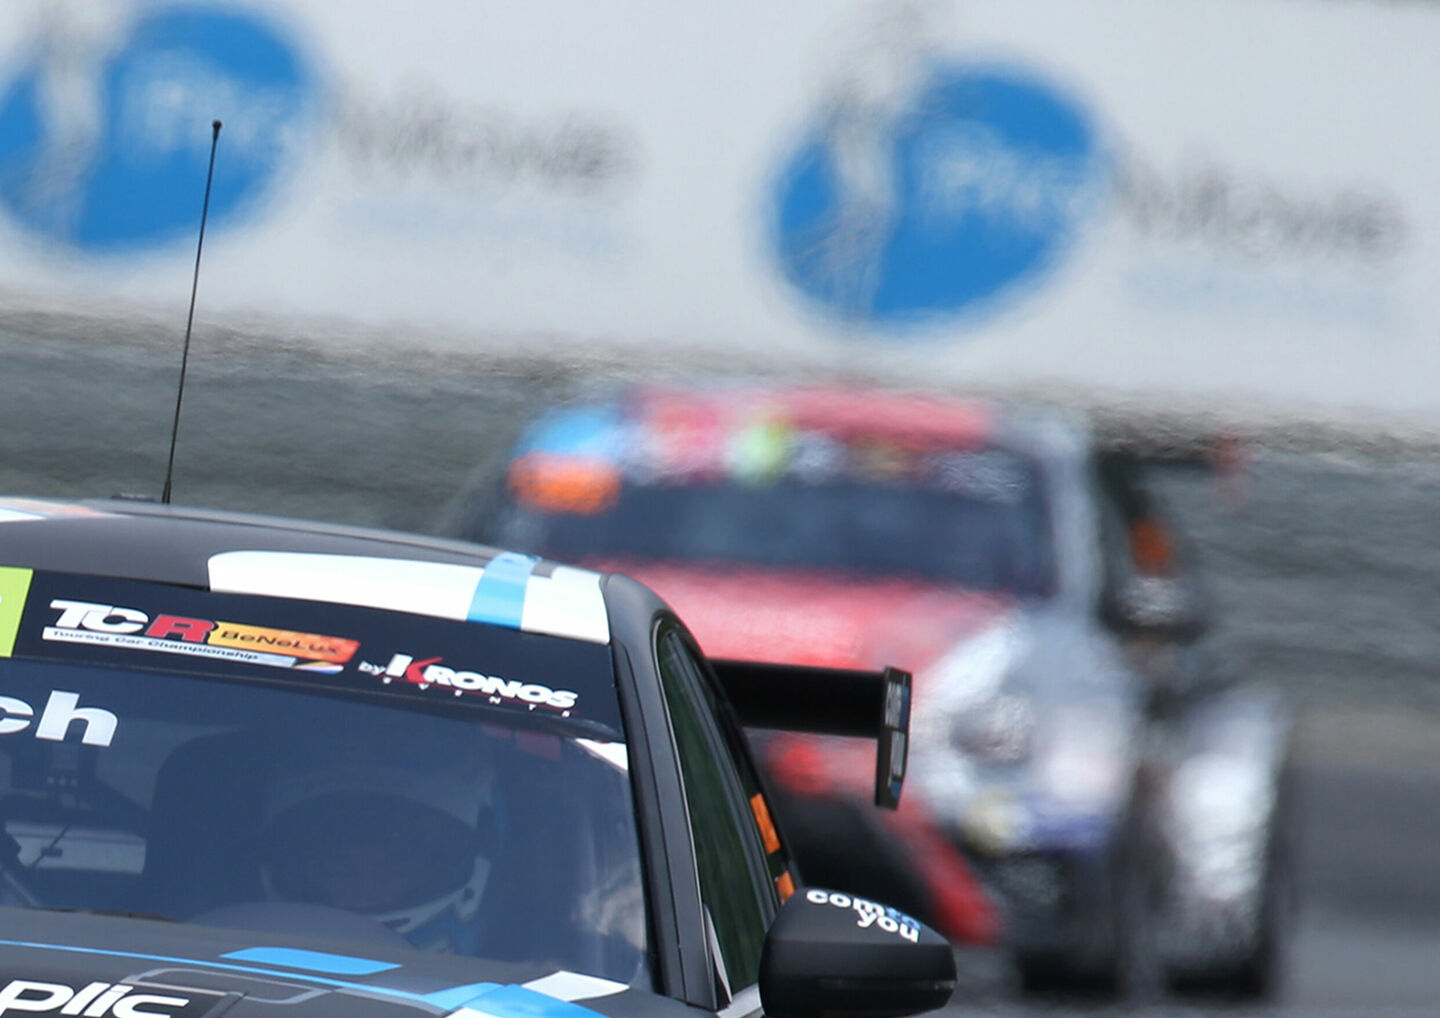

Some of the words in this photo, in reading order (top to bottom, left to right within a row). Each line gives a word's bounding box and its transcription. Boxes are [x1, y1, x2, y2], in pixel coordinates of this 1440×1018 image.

[49, 600, 215, 643] TCR
[220, 630, 340, 656] BeNeLux
[147, 640, 260, 661] Championship
[358, 661, 386, 676] by
[385, 653, 578, 709] KRONOS
[857, 909, 919, 943] you
